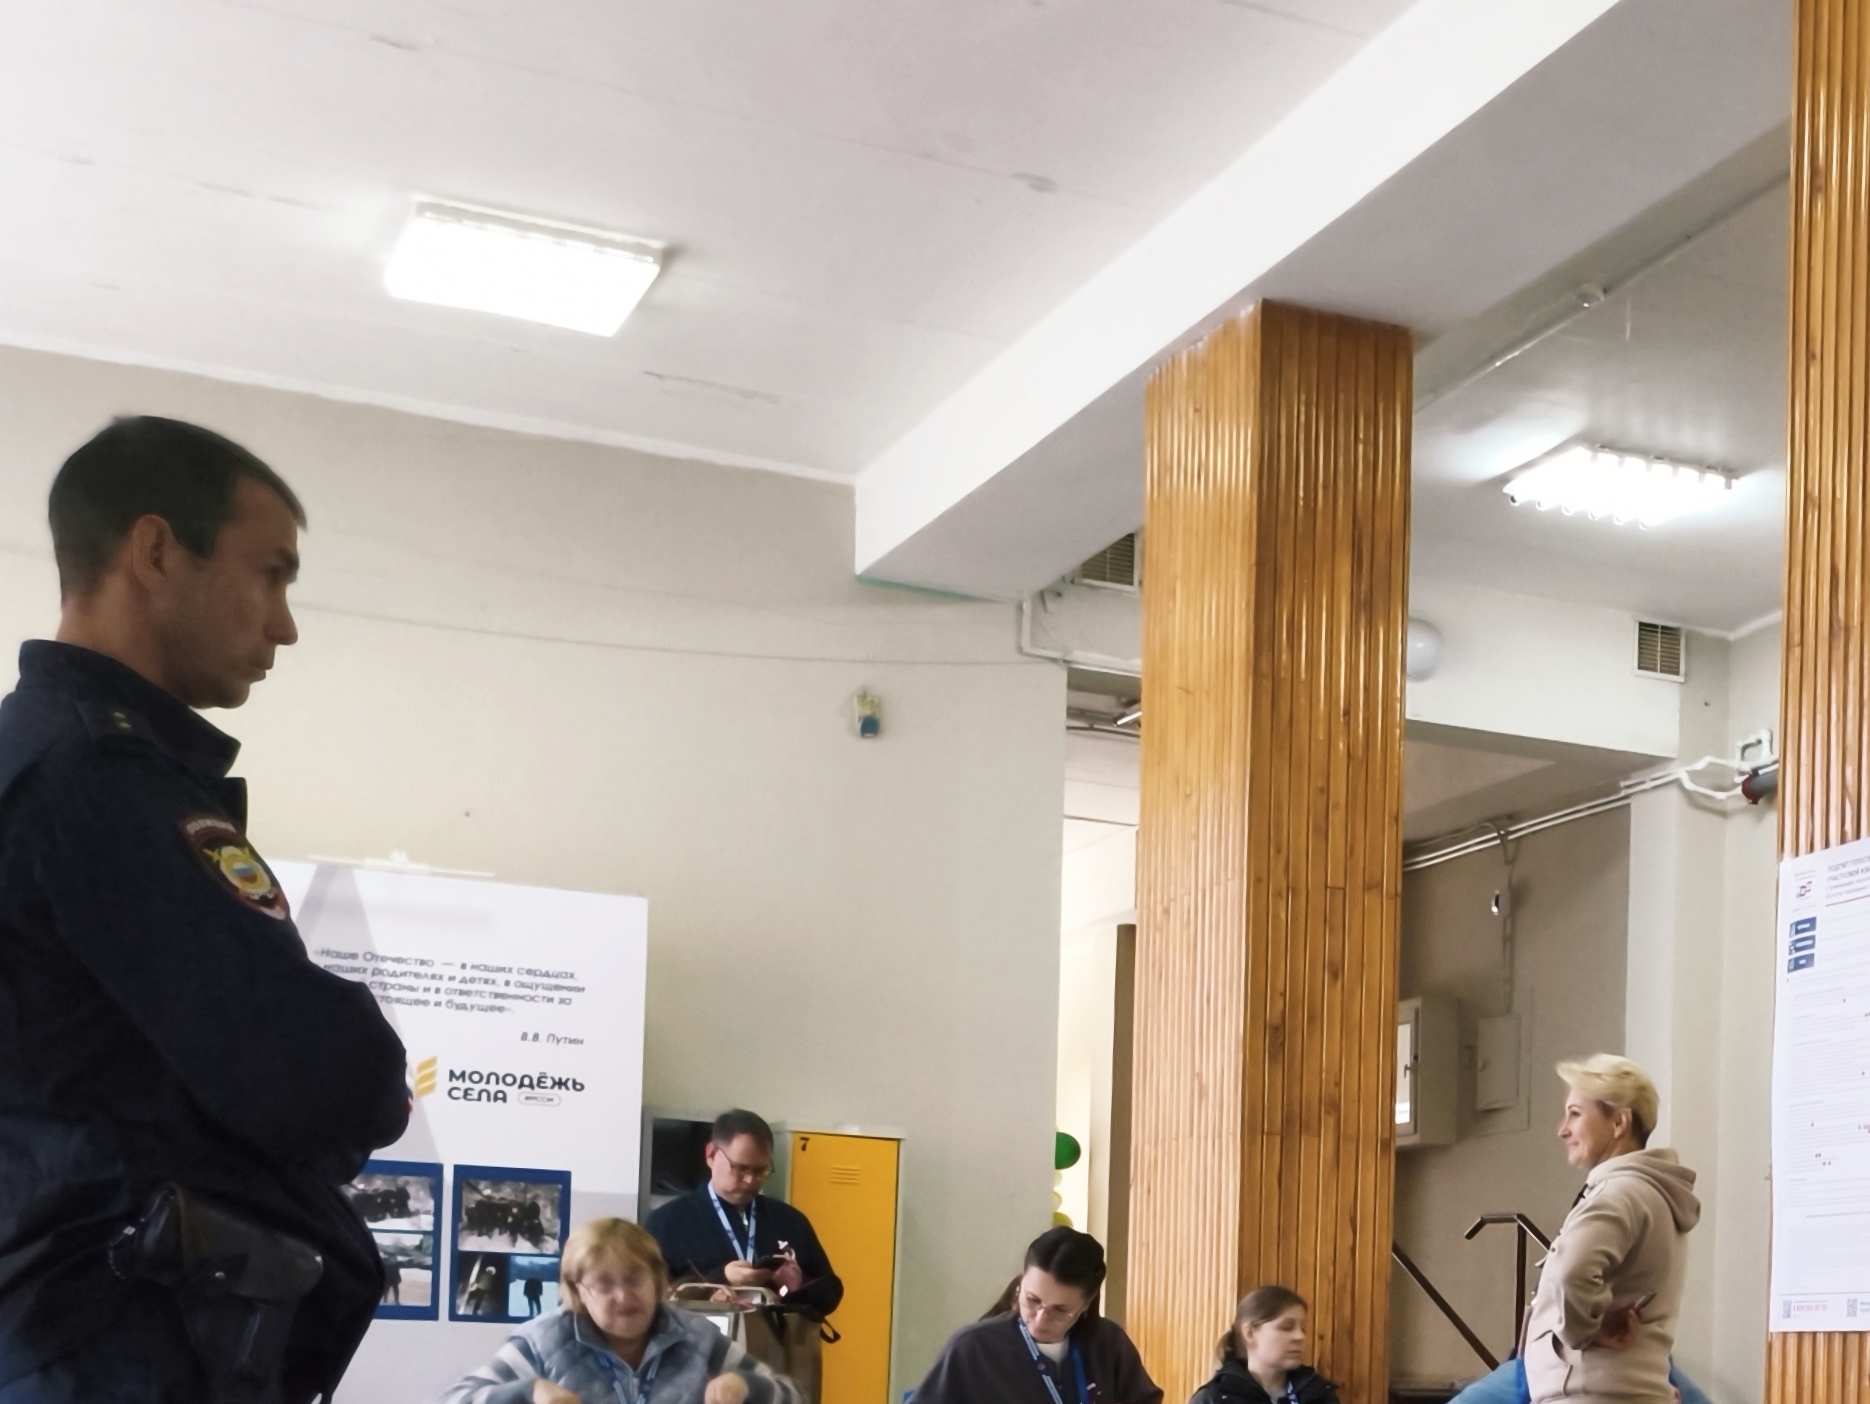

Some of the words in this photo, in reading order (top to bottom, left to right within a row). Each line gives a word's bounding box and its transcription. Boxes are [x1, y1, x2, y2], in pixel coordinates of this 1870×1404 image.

[371, 967, 444, 981] родителях
[470, 964, 513, 974] наших
[520, 1031, 542, 1043] В.В.
[546, 1033, 584, 1046] Путин
[448, 1069, 585, 1092] МОЛОДЁЖЬ
[447, 1086, 508, 1104] СЕЛА
[799, 1136, 810, 1151] 7
